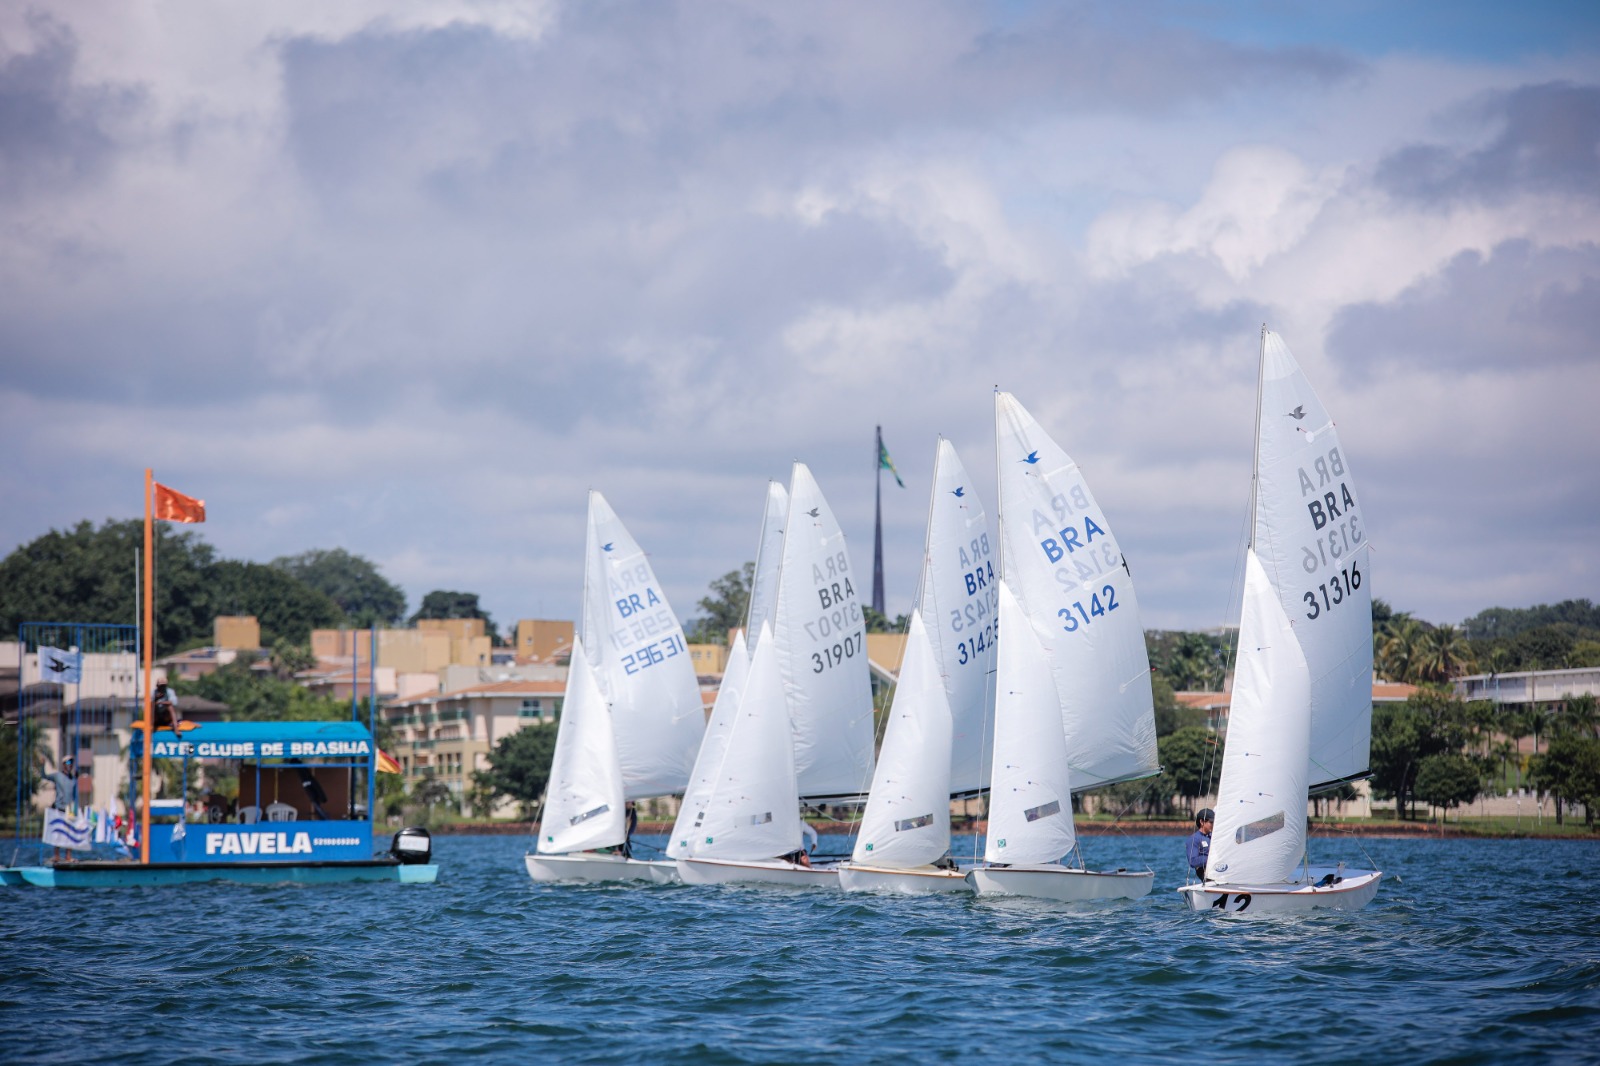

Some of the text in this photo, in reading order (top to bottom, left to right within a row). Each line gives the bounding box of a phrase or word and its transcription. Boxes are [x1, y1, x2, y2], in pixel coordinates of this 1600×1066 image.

[1307, 482, 1355, 531] BRA
[1040, 516, 1105, 564] BRA
[818, 577, 855, 610] BRA
[964, 560, 995, 596] BRA
[1303, 560, 1361, 620] 31316
[616, 587, 660, 618] BRA
[1057, 584, 1119, 632] 3142
[620, 634, 684, 675] 29631
[811, 631, 862, 673] 31907
[150, 742, 191, 756] ATE
[198, 742, 255, 756] CLUBE
[261, 742, 284, 756] DE
[205, 832, 313, 854] FAVELA
